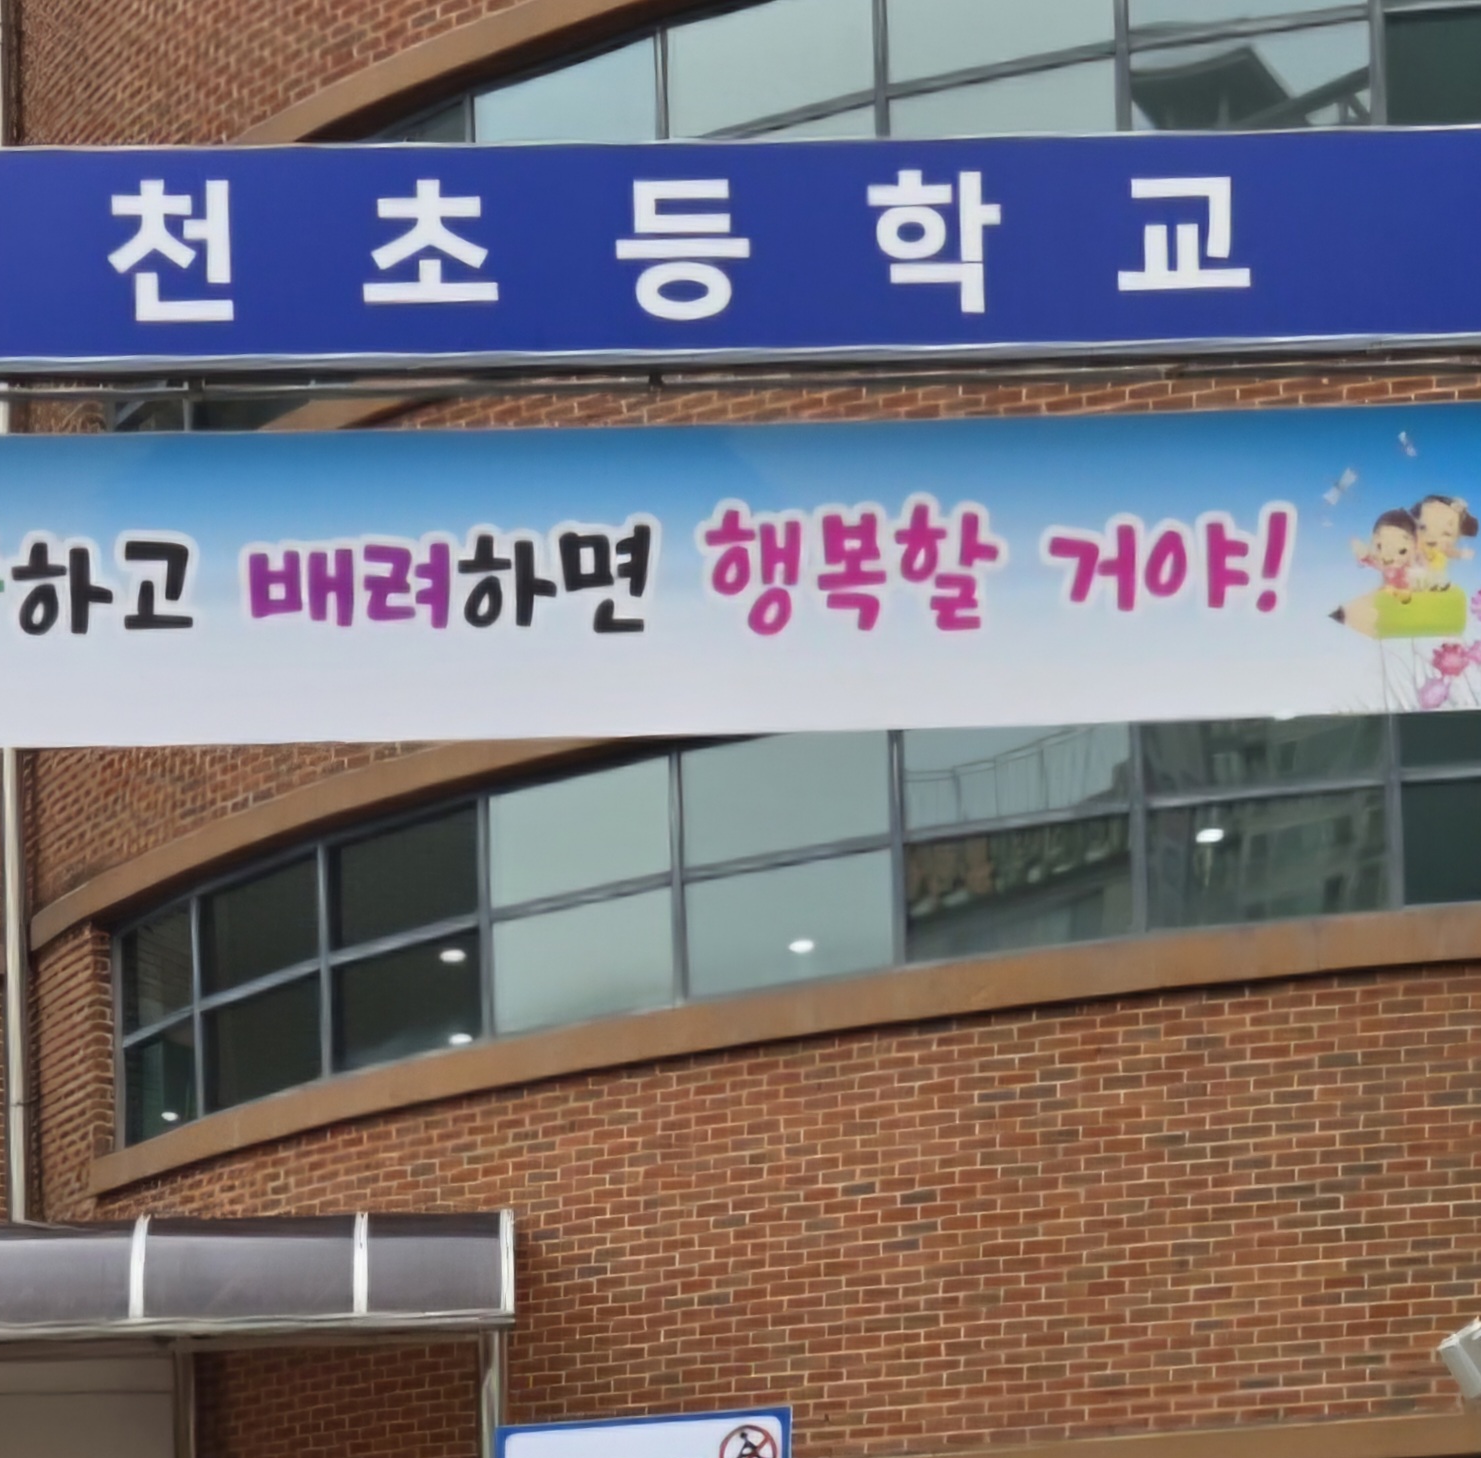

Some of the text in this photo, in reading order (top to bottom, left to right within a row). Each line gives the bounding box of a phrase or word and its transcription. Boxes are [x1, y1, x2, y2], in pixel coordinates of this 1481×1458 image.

[248, 519, 653, 633] 배려하면
[705, 497, 999, 635] 행복할
[1048, 508, 1288, 614] 거야!
